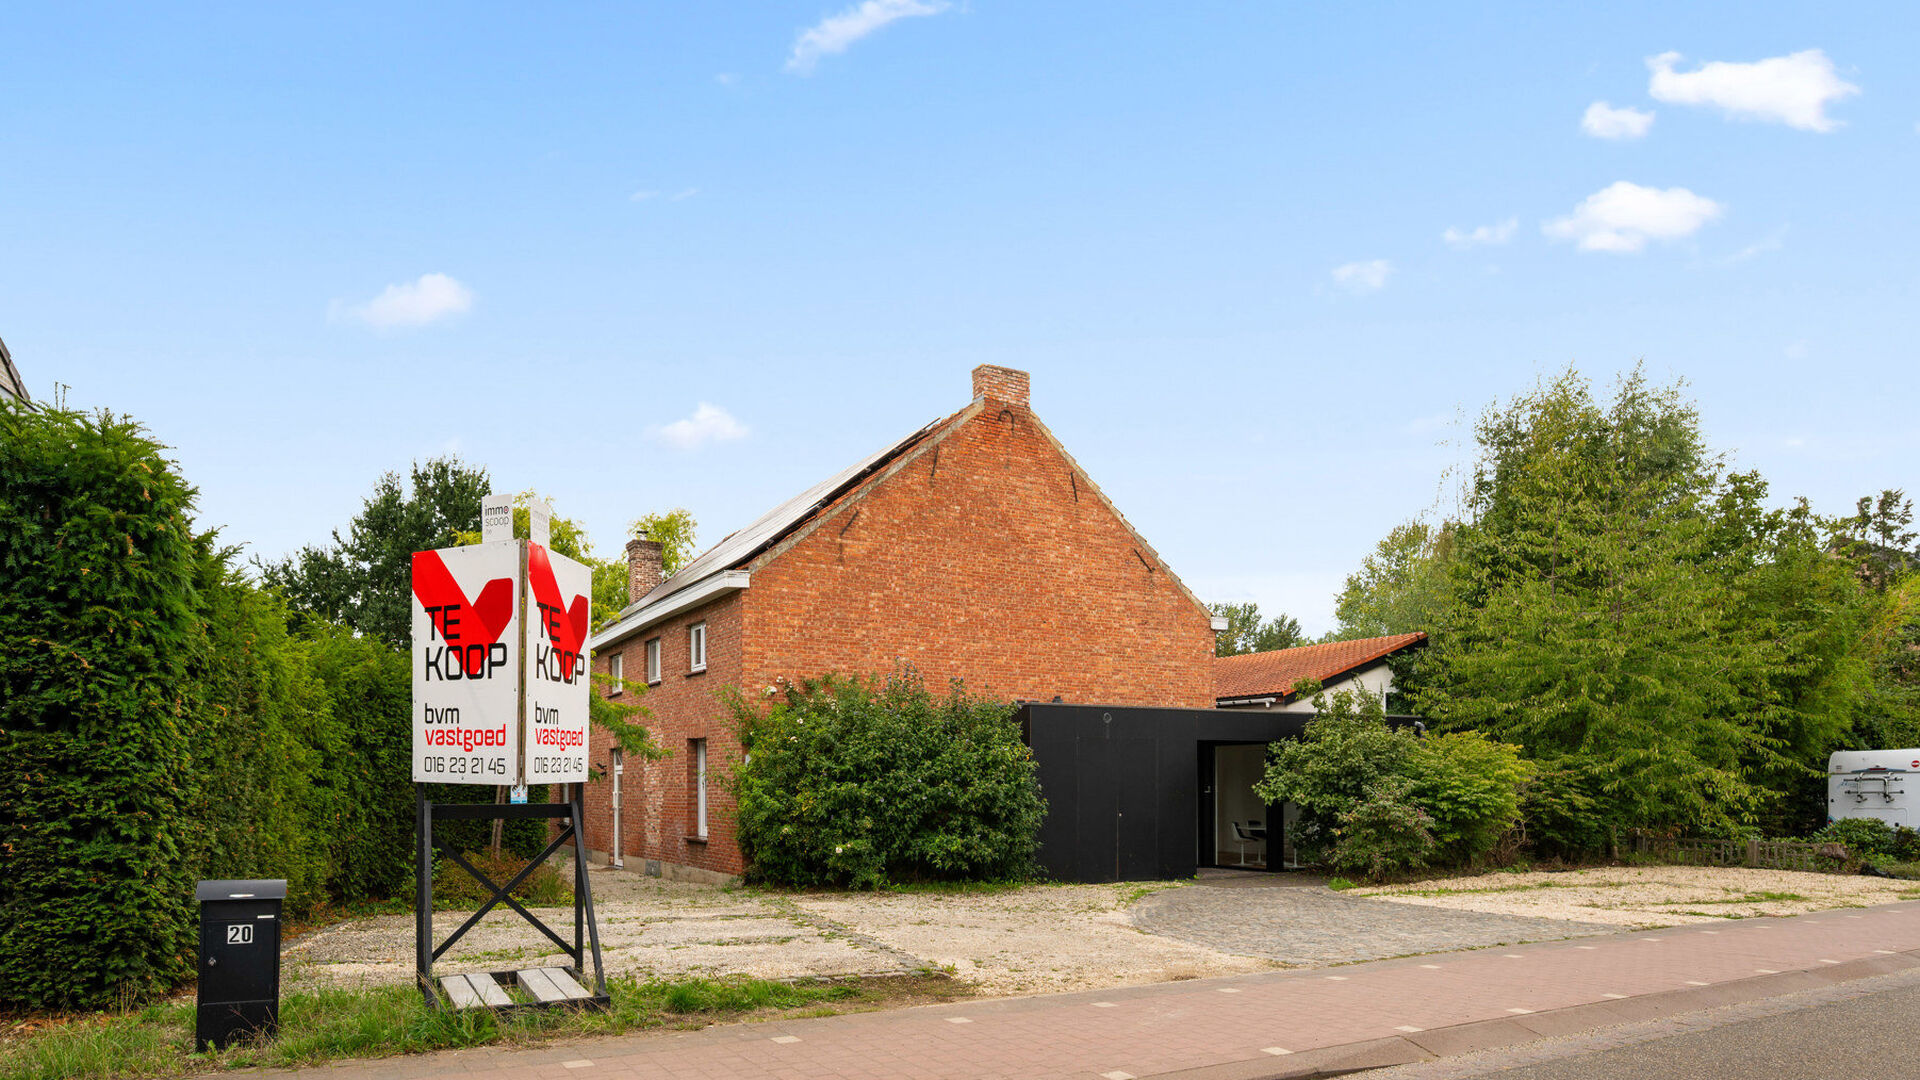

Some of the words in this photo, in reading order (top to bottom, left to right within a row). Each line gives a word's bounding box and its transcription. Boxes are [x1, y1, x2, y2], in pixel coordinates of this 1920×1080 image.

[485, 504, 509, 516] immo
[485, 516, 510, 527] scoop
[425, 604, 461, 641] TE
[537, 601, 561, 642] TE
[426, 642, 507, 681] KOOP
[536, 643, 585, 685] KOOP
[425, 703, 459, 724] bvm
[535, 701, 559, 725] bvm
[425, 723, 506, 752] vastgoed
[535, 726, 583, 751] vastgoed
[424, 756, 445, 773] 016
[449, 757, 466, 774] 23
[471, 757, 484, 774] 21
[488, 757, 506, 775] 45
[534, 757, 549, 774] 016
[551, 757, 562, 774] 23
[563, 757, 571, 773] 21
[572, 757, 583, 773] 45
[229, 926, 252, 943] 20
